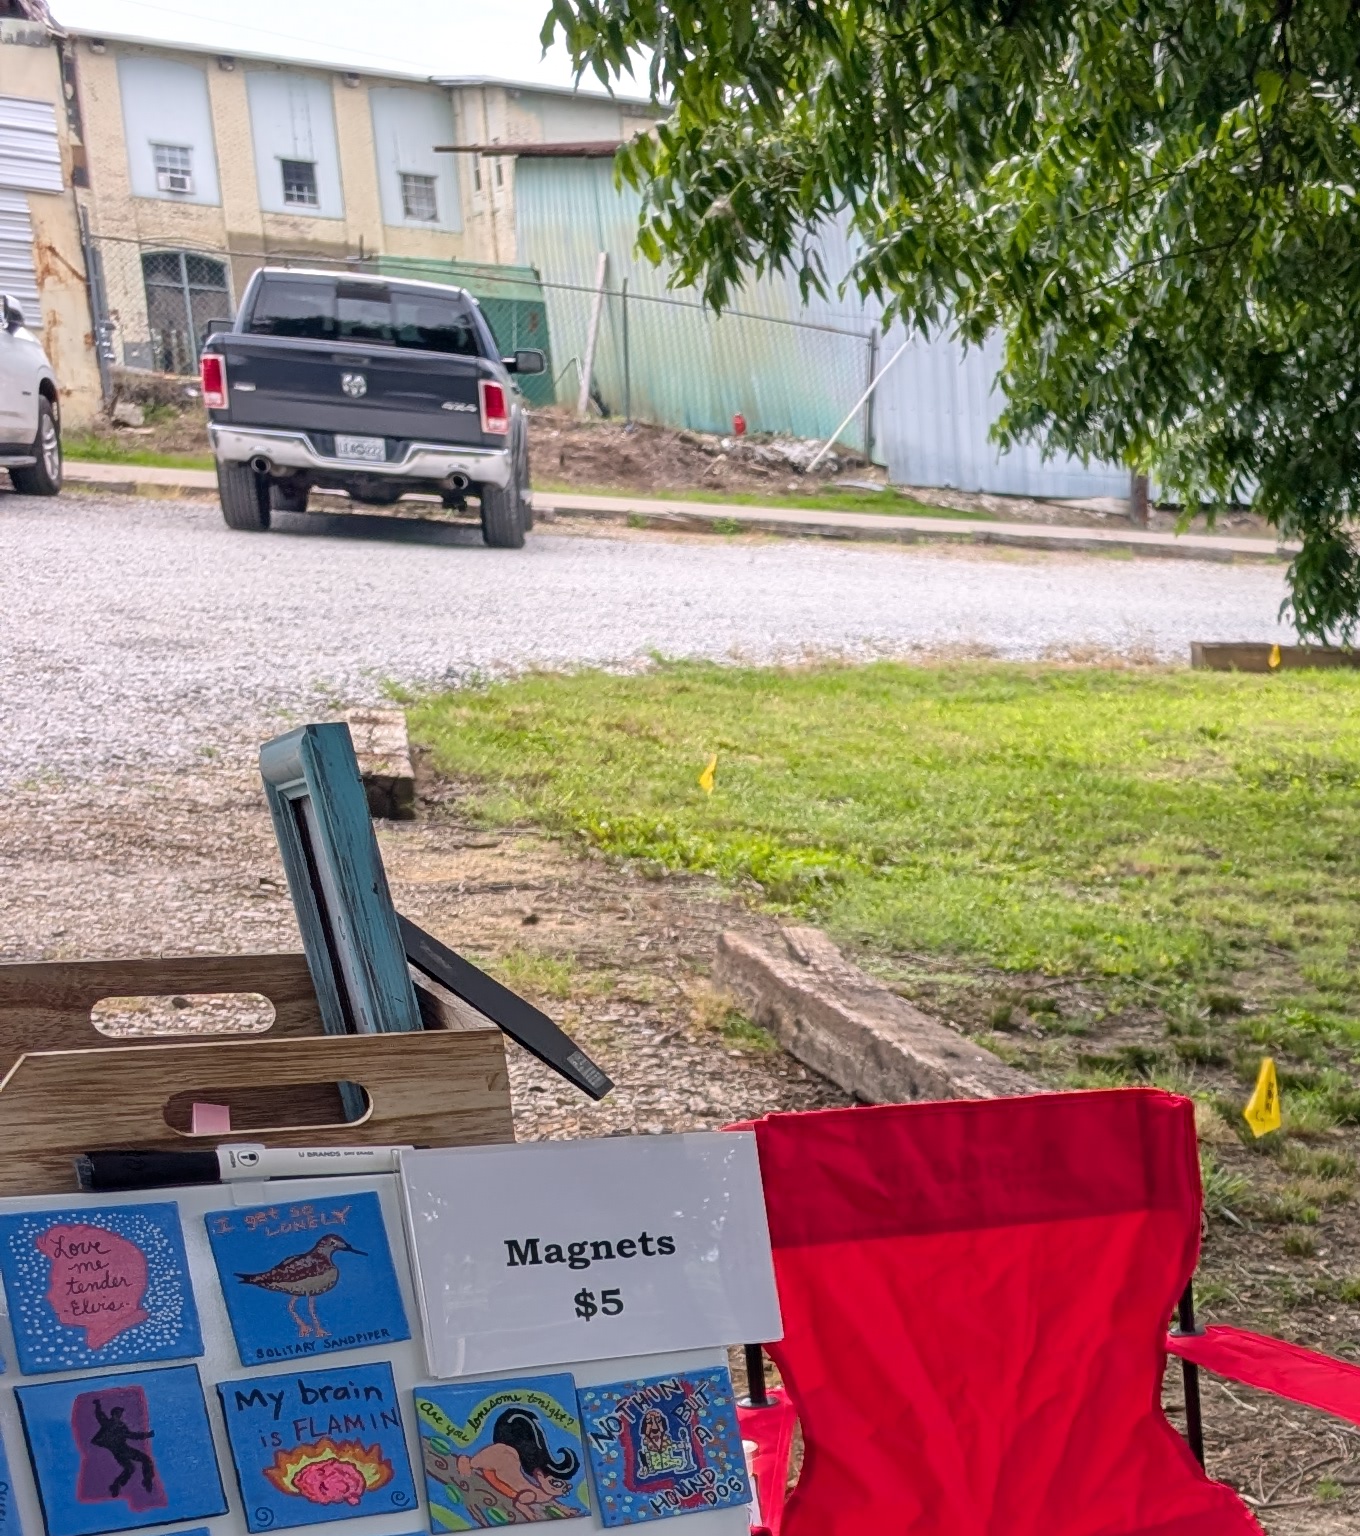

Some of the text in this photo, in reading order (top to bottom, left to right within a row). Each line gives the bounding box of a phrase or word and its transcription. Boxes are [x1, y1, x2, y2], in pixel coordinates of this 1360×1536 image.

[51, 1235, 111, 1259] Love
[504, 1232, 676, 1270] Magnets
[66, 1270, 132, 1295] tender
[68, 1260, 109, 1271] me
[574, 1288, 624, 1322] $5
[257, 1328, 390, 1358] SOLITARY SANDPIPER
[235, 1379, 383, 1420] My brain
[420, 1403, 443, 1424] Are
[446, 1425, 469, 1441] you
[467, 1394, 522, 1432] lonesome
[588, 1377, 710, 1454] NOTHIN BUT
[259, 1407, 399, 1447] is FLAMIN
[693, 1425, 714, 1446] A
[650, 1467, 743, 1514] HOUND DOG
